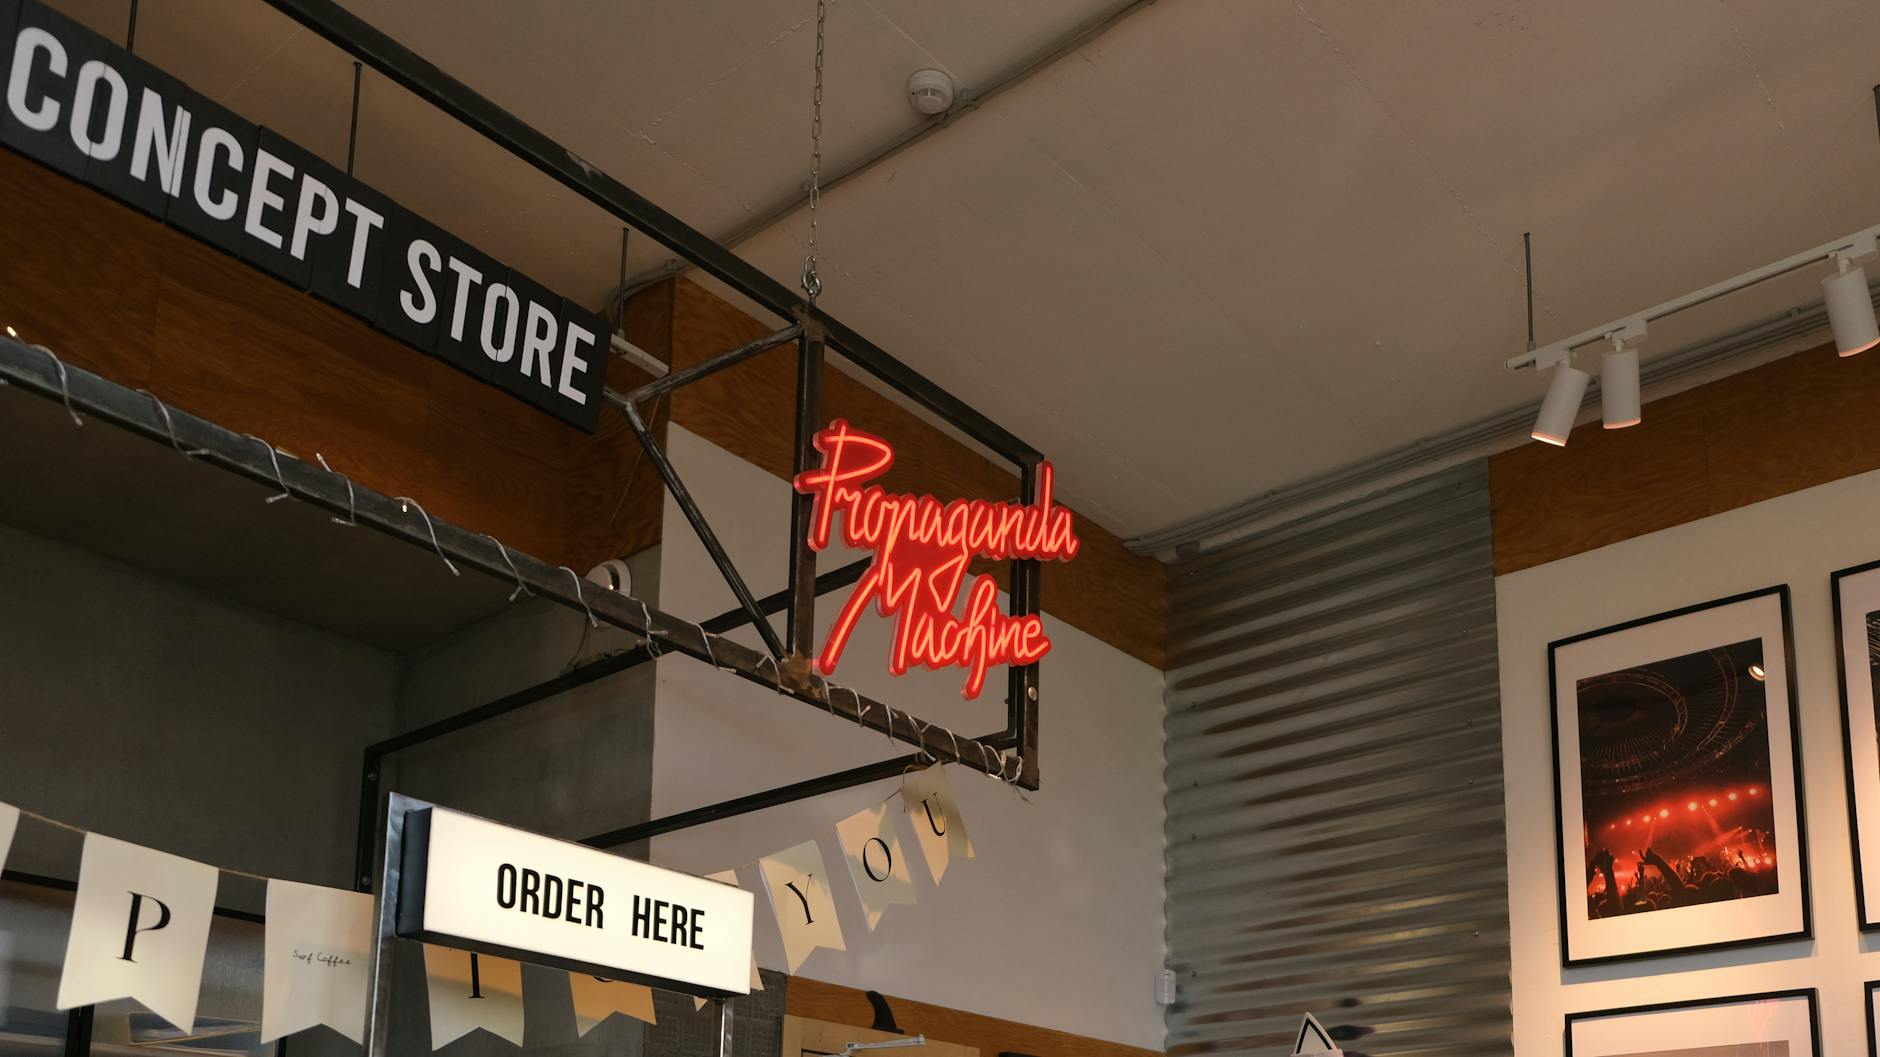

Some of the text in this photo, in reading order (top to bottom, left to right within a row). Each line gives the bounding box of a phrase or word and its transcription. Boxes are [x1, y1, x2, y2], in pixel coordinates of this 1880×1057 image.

[7, 27, 596, 405] CONCEPT STORE
[799, 420, 1079, 613] Propaganda
[817, 562, 1051, 697] Machine
[317, 952, 352, 968] Coffee
[496, 863, 705, 951] ORDER HERE
